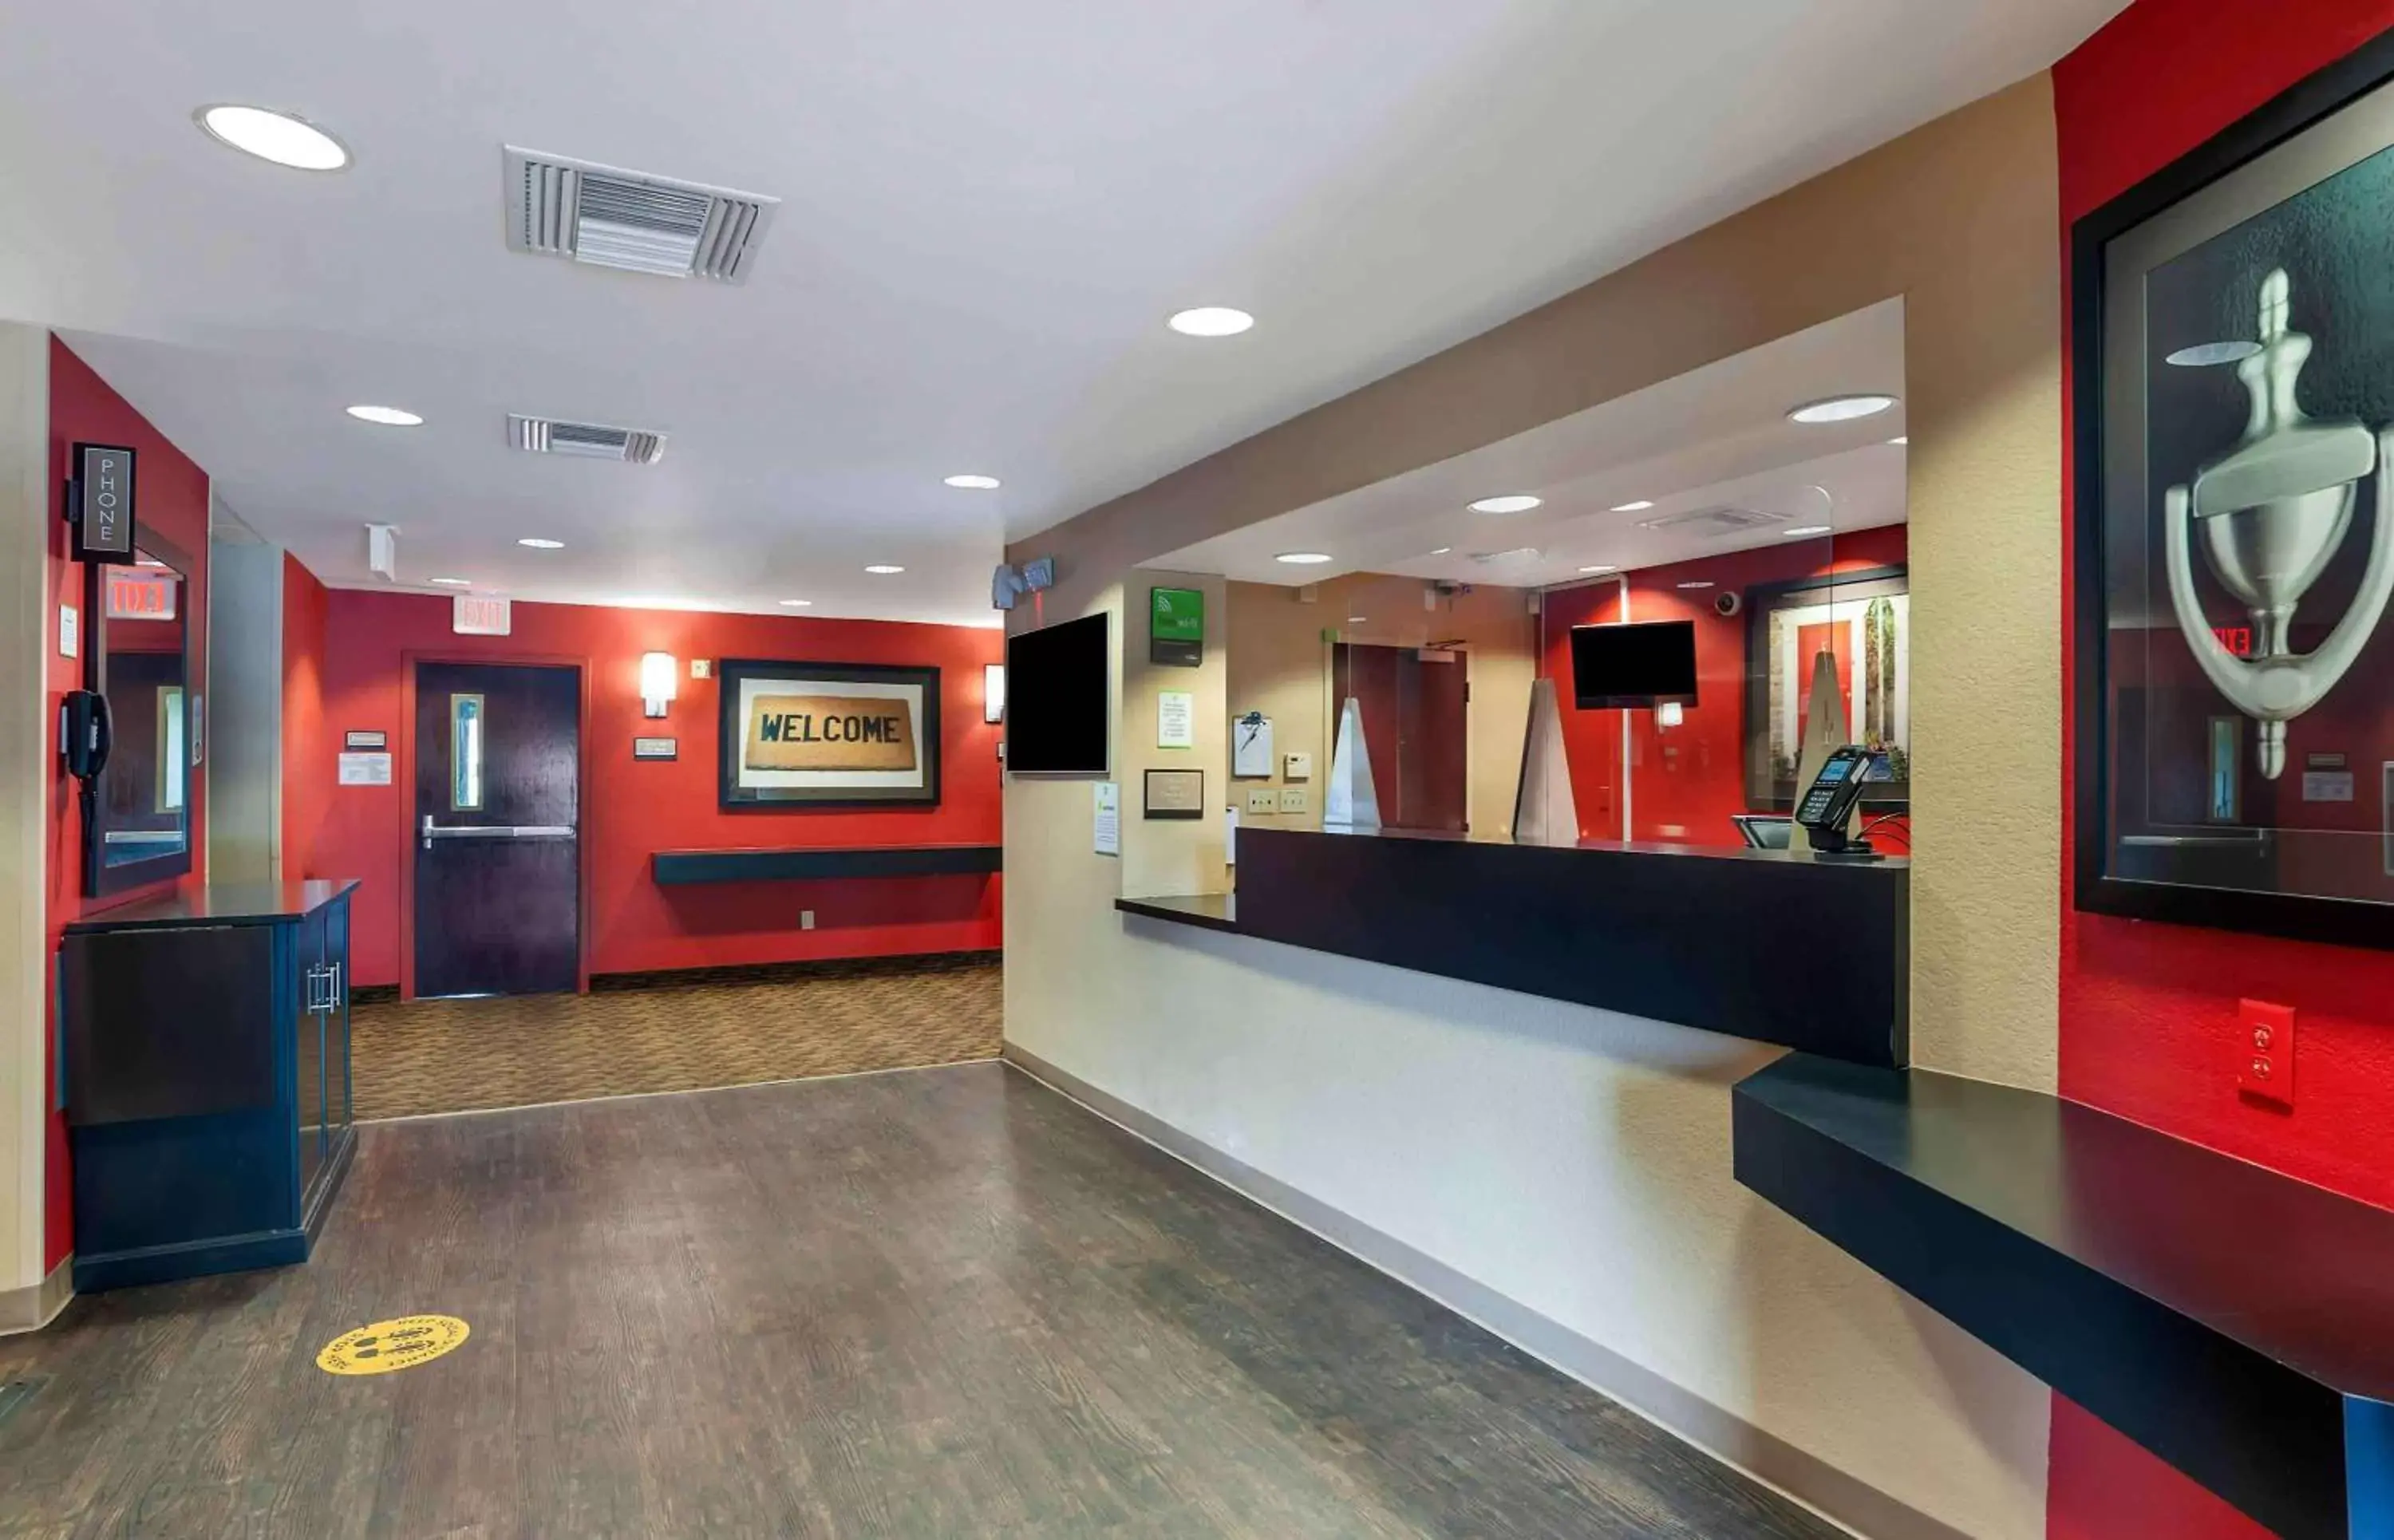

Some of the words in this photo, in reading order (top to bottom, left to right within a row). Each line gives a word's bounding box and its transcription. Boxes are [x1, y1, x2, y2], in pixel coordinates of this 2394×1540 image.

[97, 459, 117, 541] PHONE
[464, 601, 501, 627] EXIT
[760, 713, 902, 743] WELCOME
